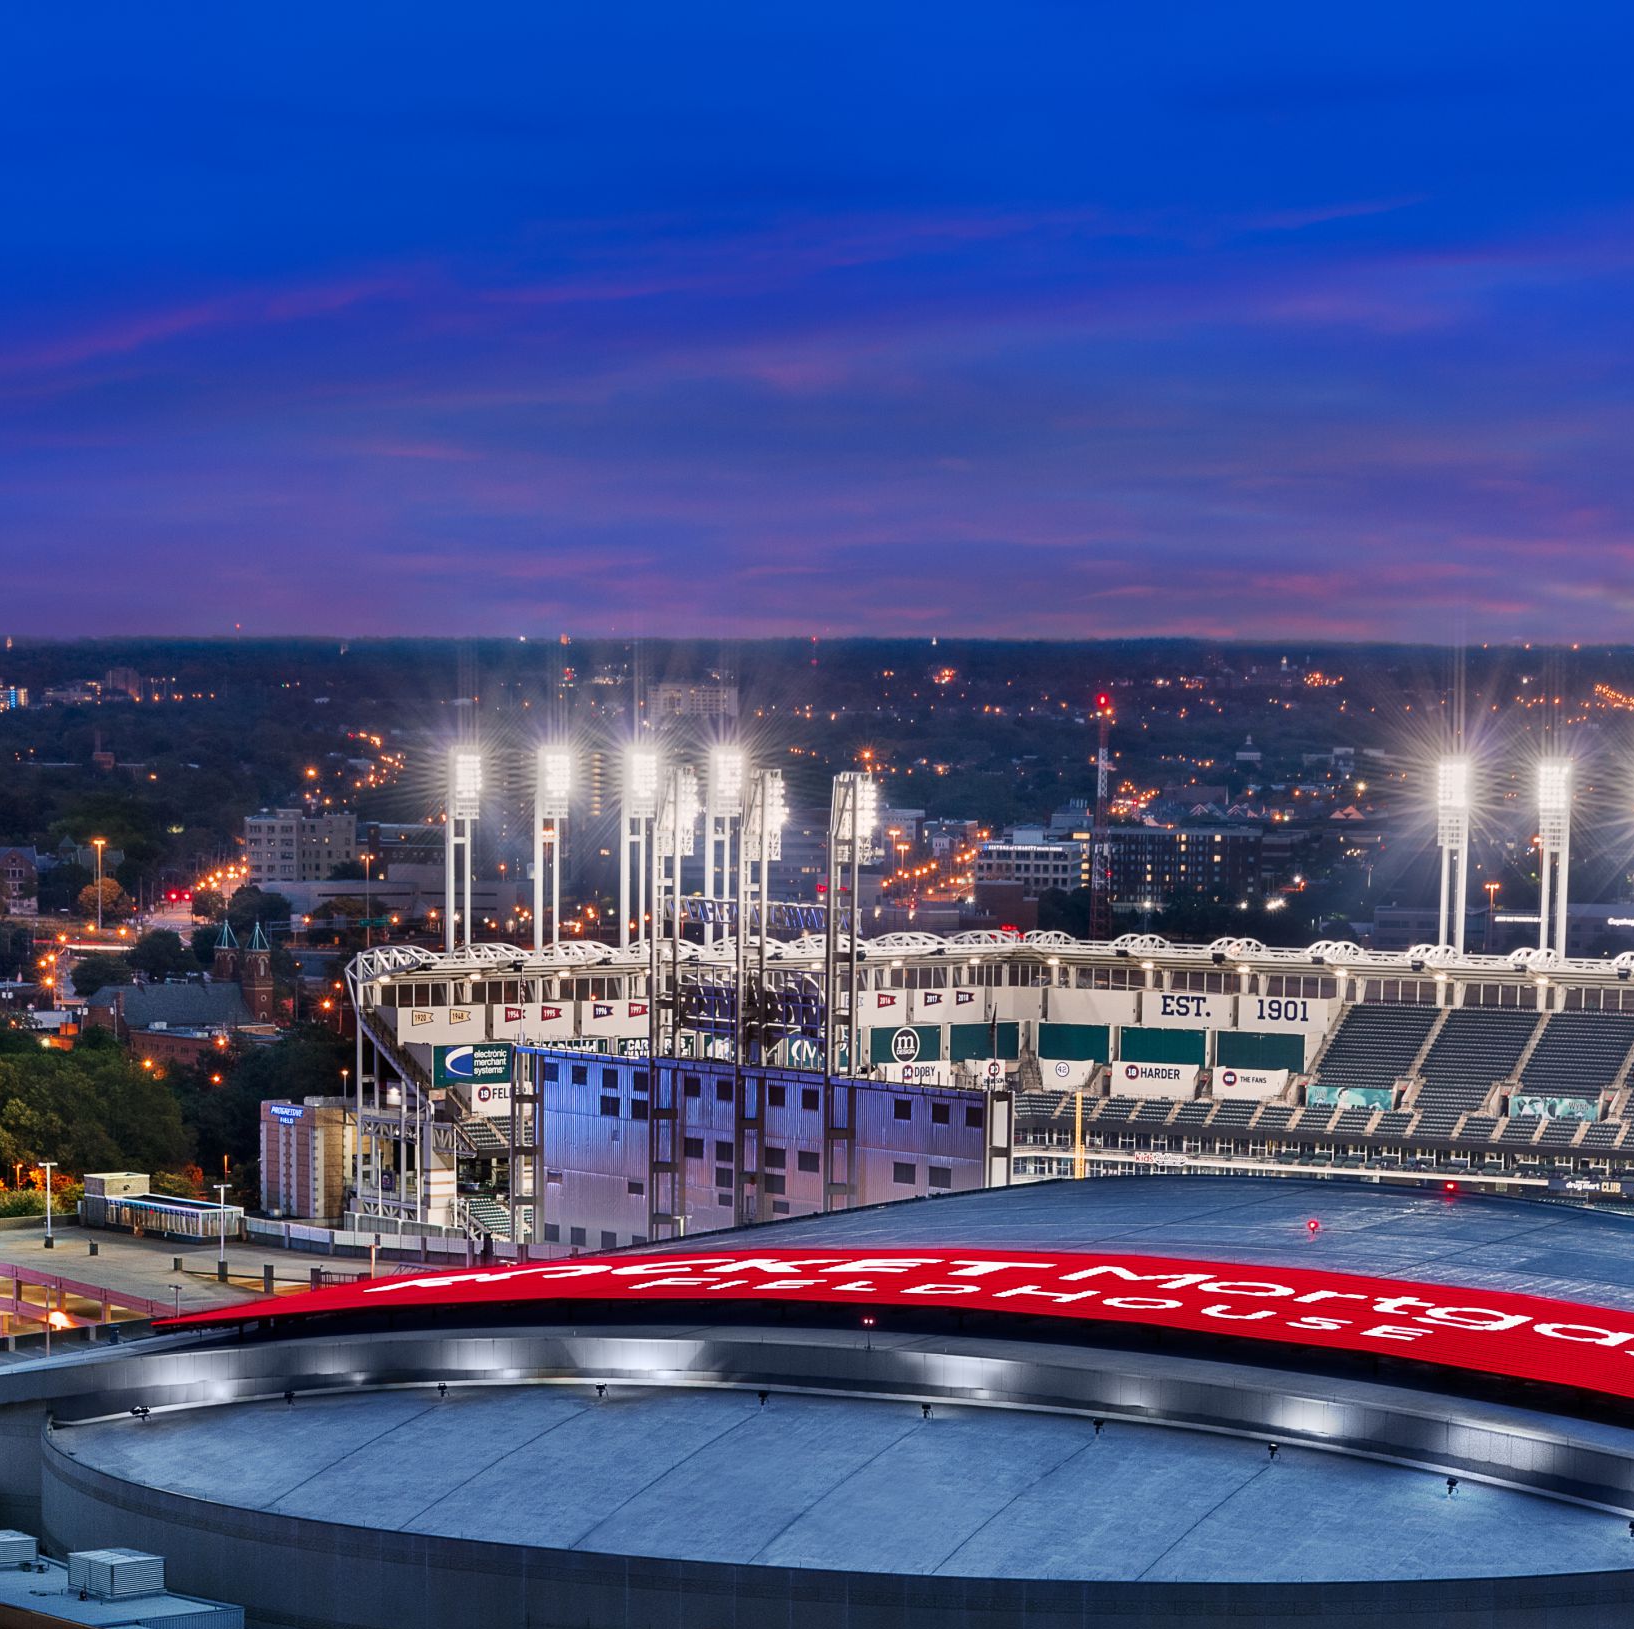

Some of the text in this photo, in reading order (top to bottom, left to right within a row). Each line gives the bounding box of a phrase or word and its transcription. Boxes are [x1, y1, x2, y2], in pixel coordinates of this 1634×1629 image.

[879, 997, 891, 1005] 2016
[926, 995, 938, 1003] 2017
[630, 1005, 642, 1014] 1997
[1161, 995, 1211, 1017] EST.
[1257, 1000, 1309, 1022] 1901
[452, 1012, 465, 1020] 1948
[543, 1009, 556, 1018] 1995
[595, 1007, 608, 1016] 1996
[414, 1013, 427, 1022] 1920
[897, 1035, 915, 1049] m
[474, 1049, 507, 1059] electronic
[474, 1057, 507, 1067] merchant
[914, 1066, 936, 1077] DOBY
[1057, 1065, 1068, 1073] 42
[1127, 1067, 1137, 1077] 18
[1140, 1067, 1180, 1080] HARDER
[1252, 1076, 1267, 1084] FANS
[480, 1089, 490, 1099] 19
[1135, 1152, 1154, 1163] kids
[1566, 1182, 1621, 1193] drug mart CLUB
[363, 1258, 1058, 1293] ROCKET
